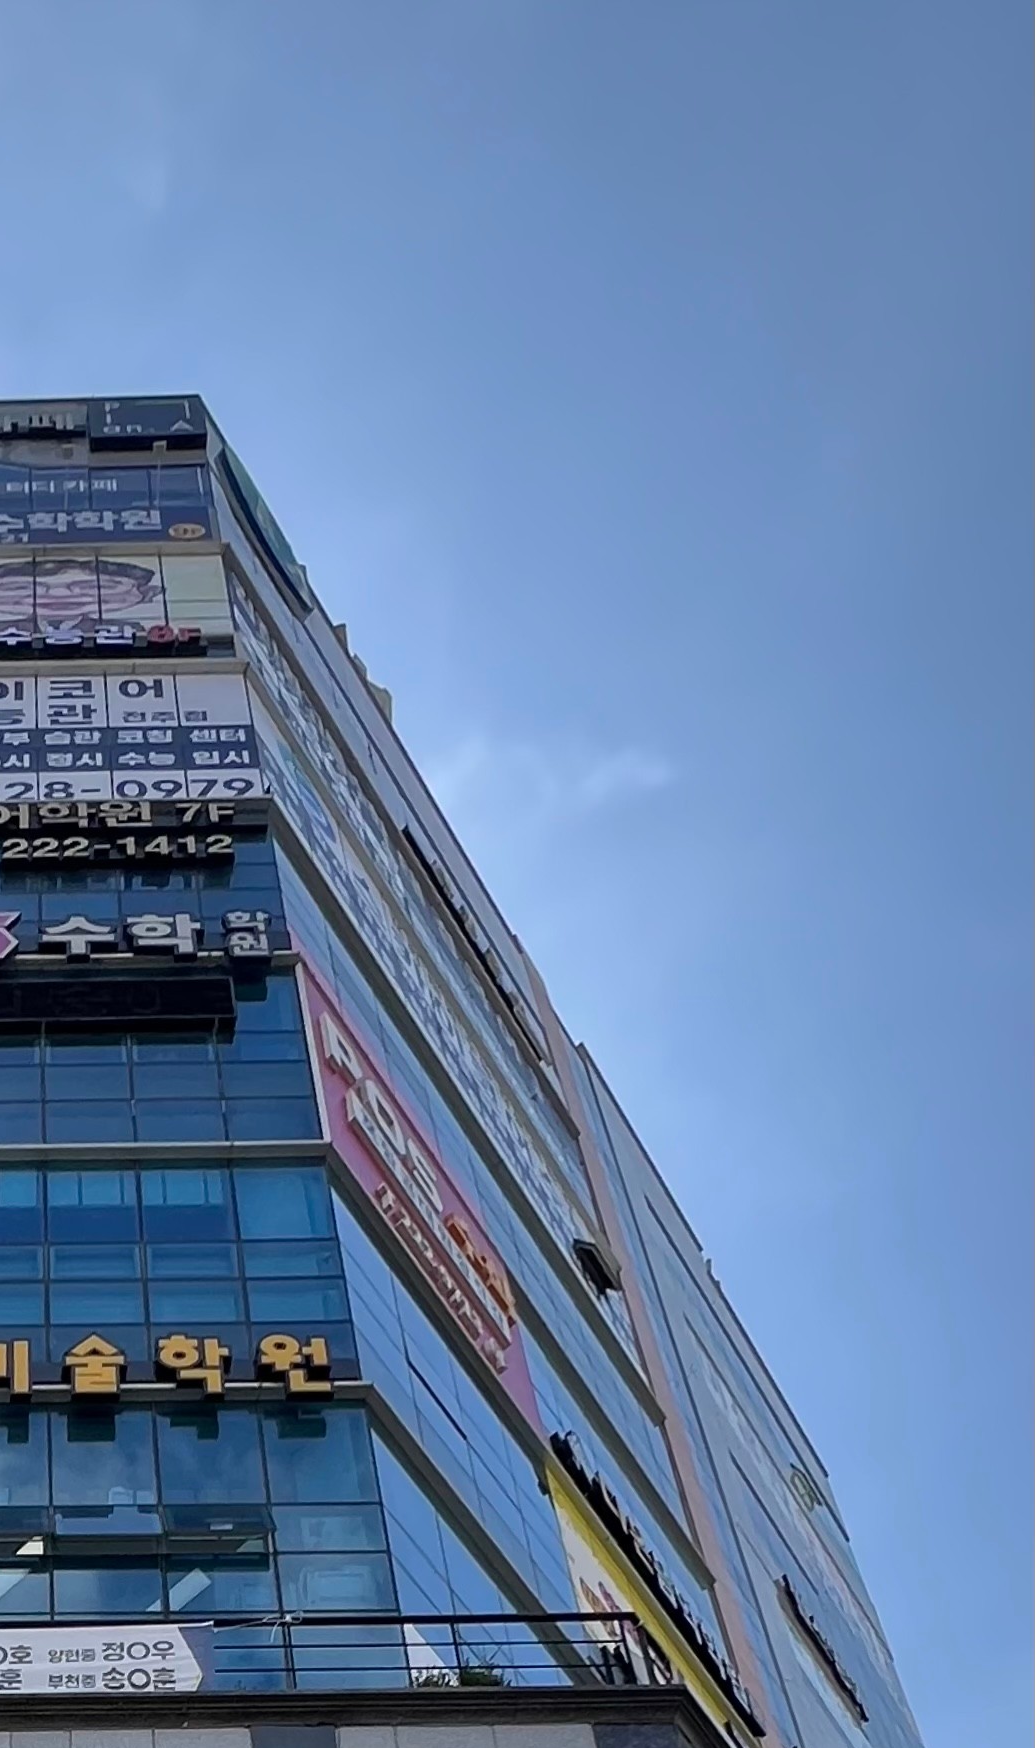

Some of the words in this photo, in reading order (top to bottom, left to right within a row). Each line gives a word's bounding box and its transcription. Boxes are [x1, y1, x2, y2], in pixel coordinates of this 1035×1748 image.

[175, 802, 235, 823] 7F
[2, 835, 233, 859] 222-1412
[39, 914, 202, 955] 수학
